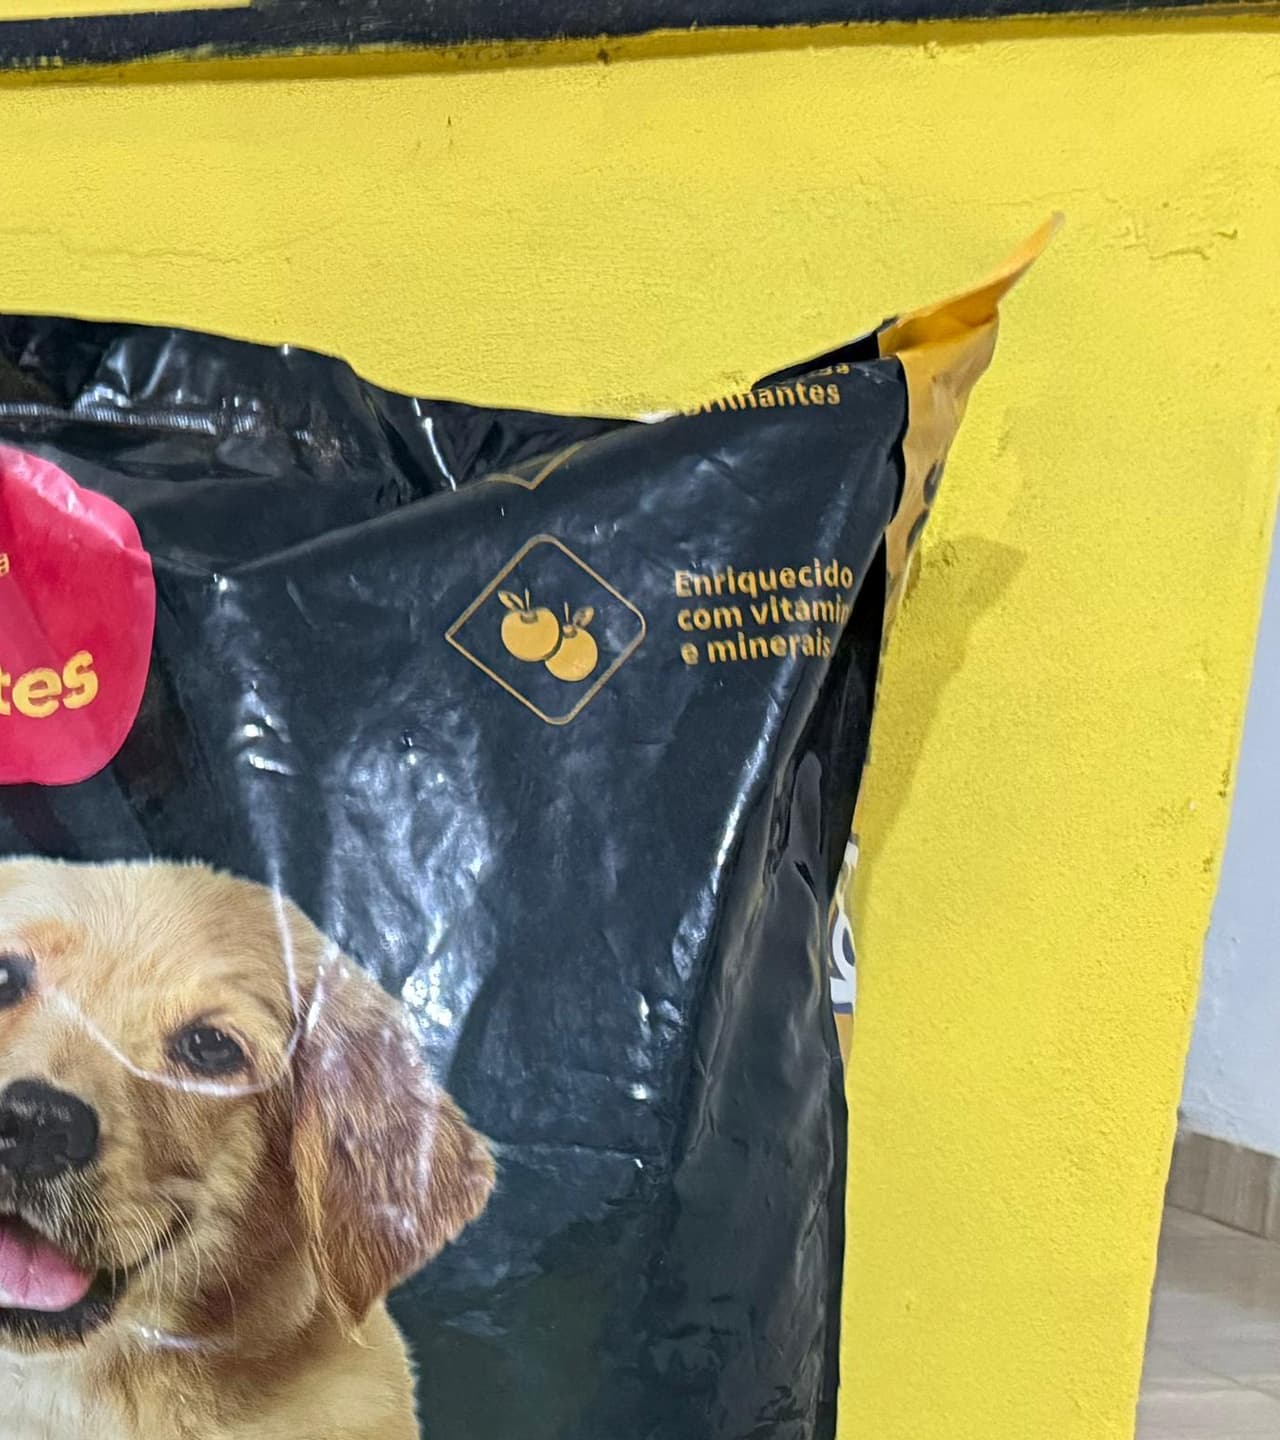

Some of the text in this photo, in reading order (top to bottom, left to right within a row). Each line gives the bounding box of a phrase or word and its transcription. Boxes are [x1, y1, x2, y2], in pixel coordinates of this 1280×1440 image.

[674, 557, 854, 599] Enriquecido
[678, 606, 743, 632] com
[681, 627, 832, 665] e minerais
